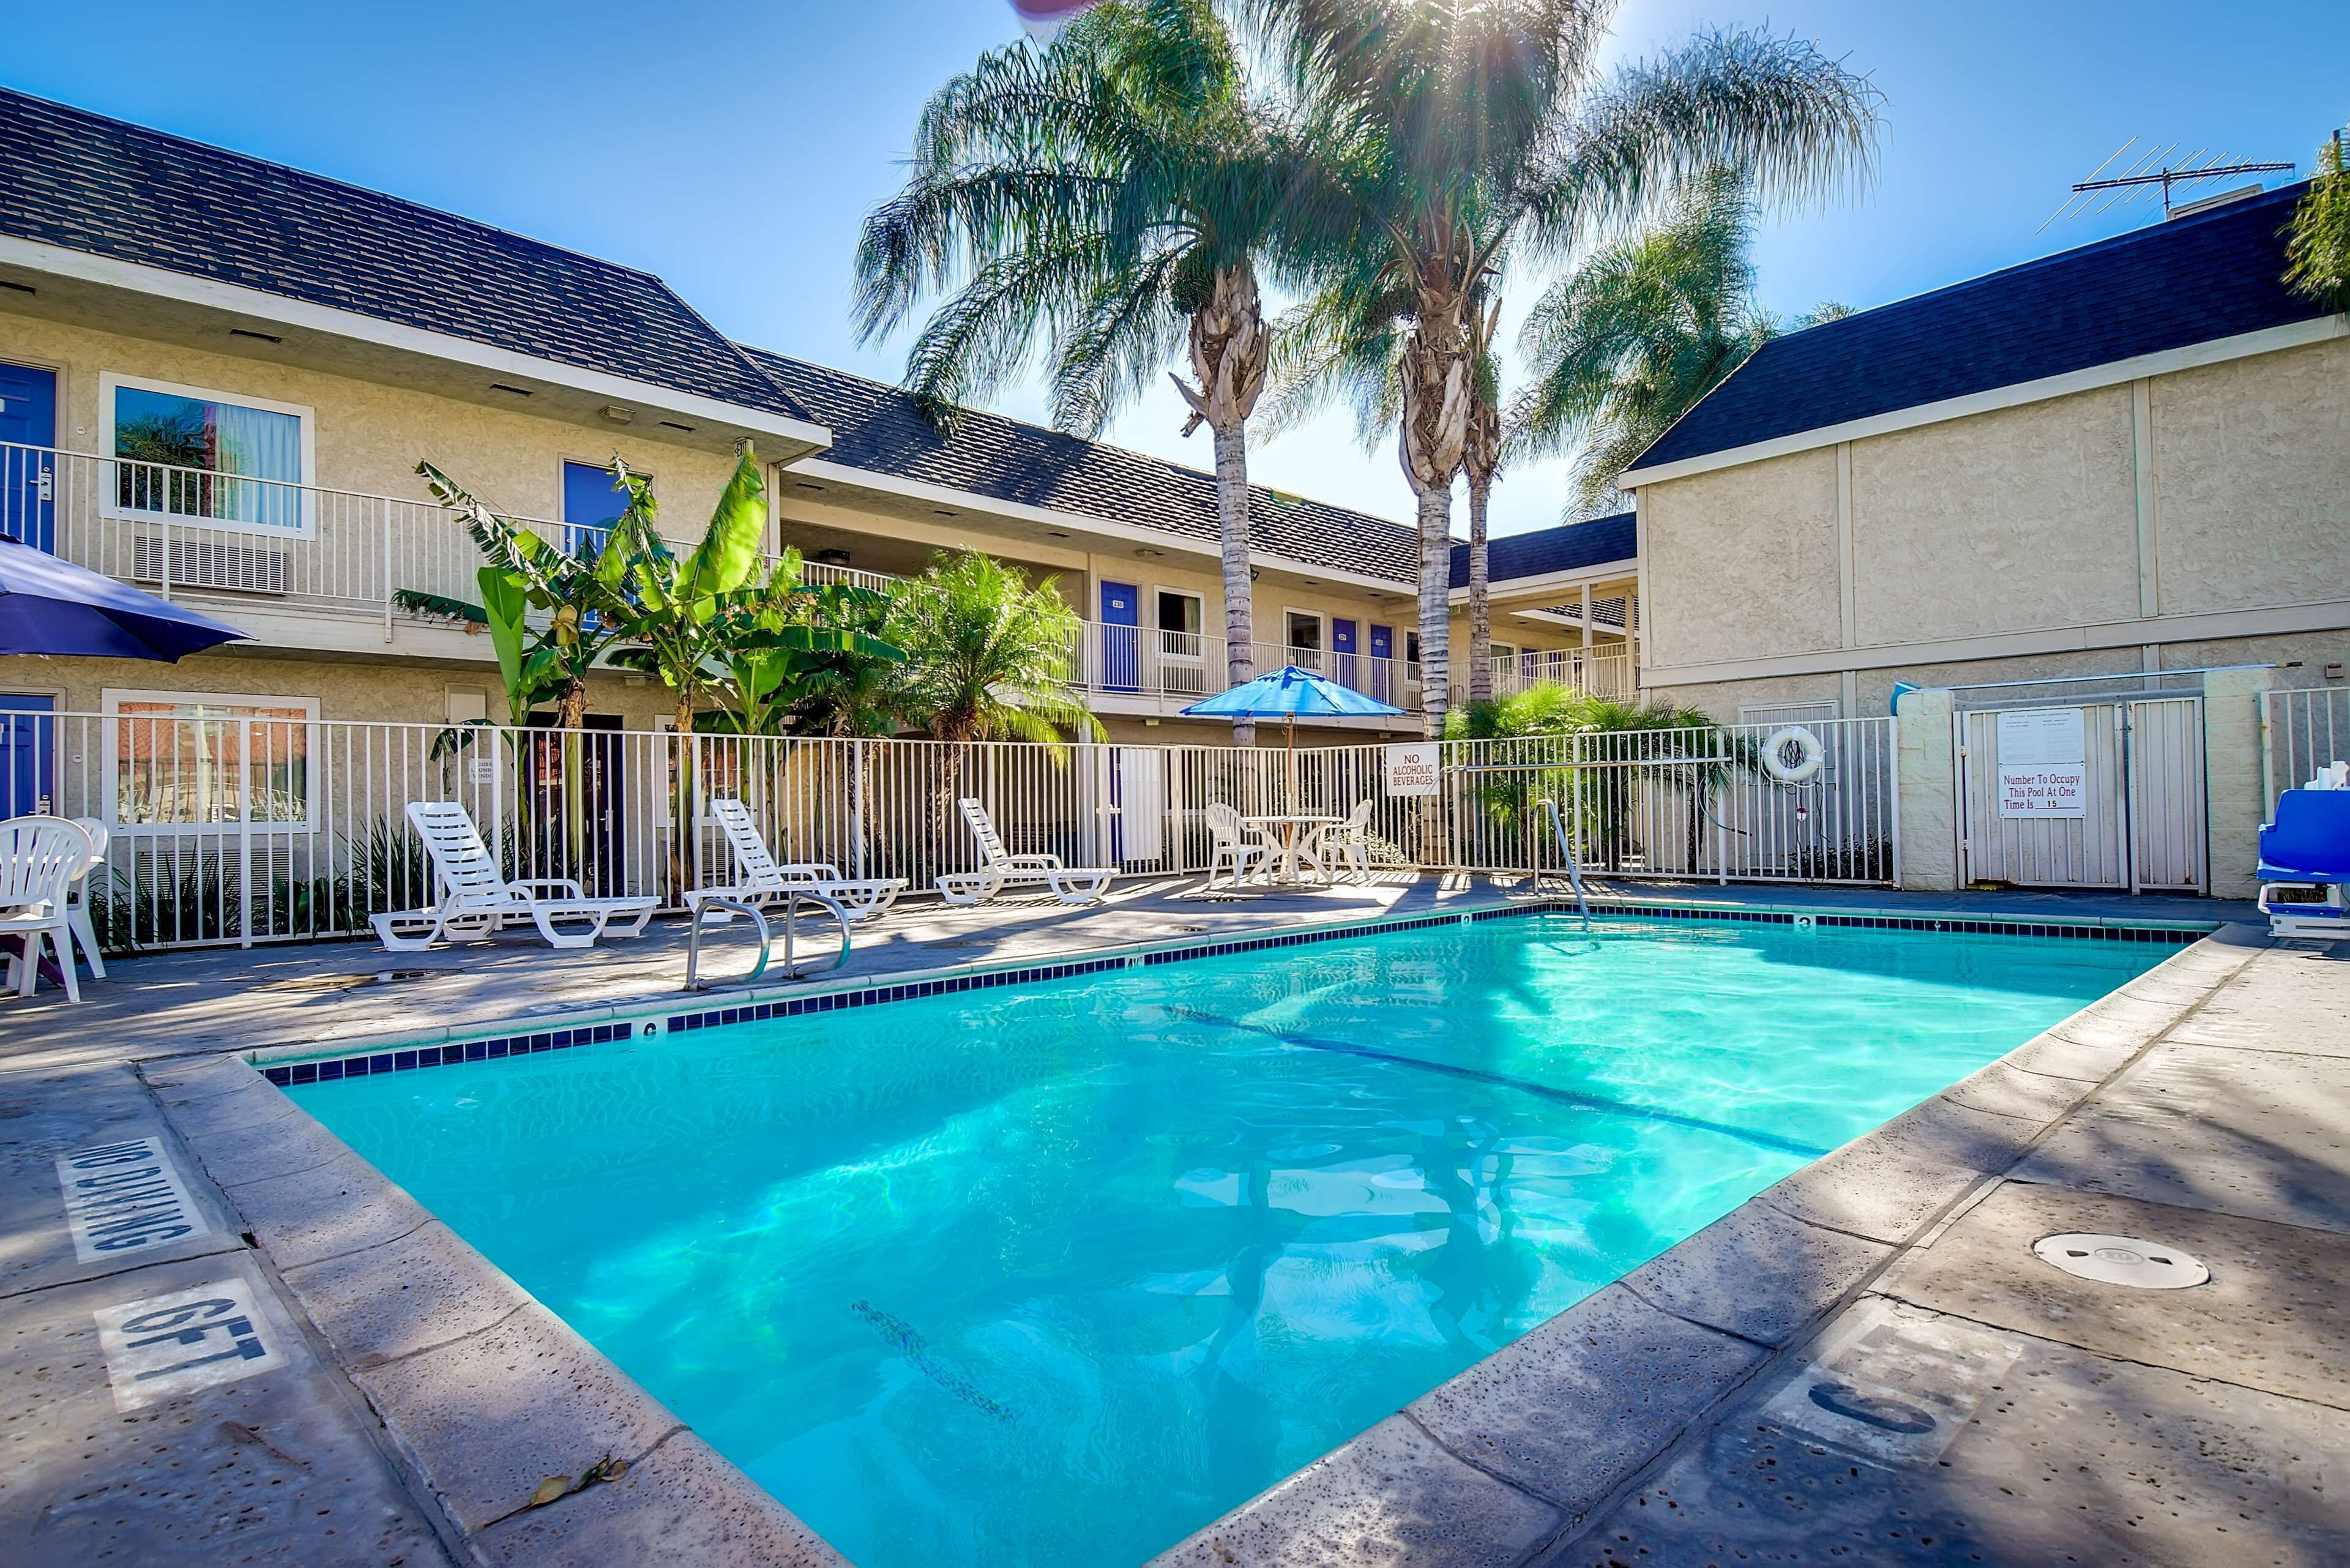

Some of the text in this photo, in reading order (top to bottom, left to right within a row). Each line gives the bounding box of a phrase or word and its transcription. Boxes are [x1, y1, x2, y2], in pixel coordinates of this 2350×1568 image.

[1404, 754, 1420, 764] NO
[1393, 764, 1433, 775] ALCOHOLIC
[1393, 775, 1433, 786] BEVERAGES
[2004, 774, 2080, 786] Number To Occupy
[2009, 786, 2076, 797] This Pool At One
[2004, 799, 2024, 809] Time
[2027, 799, 2034, 809] Is
[69, 1140, 192, 1251] NO DIVING
